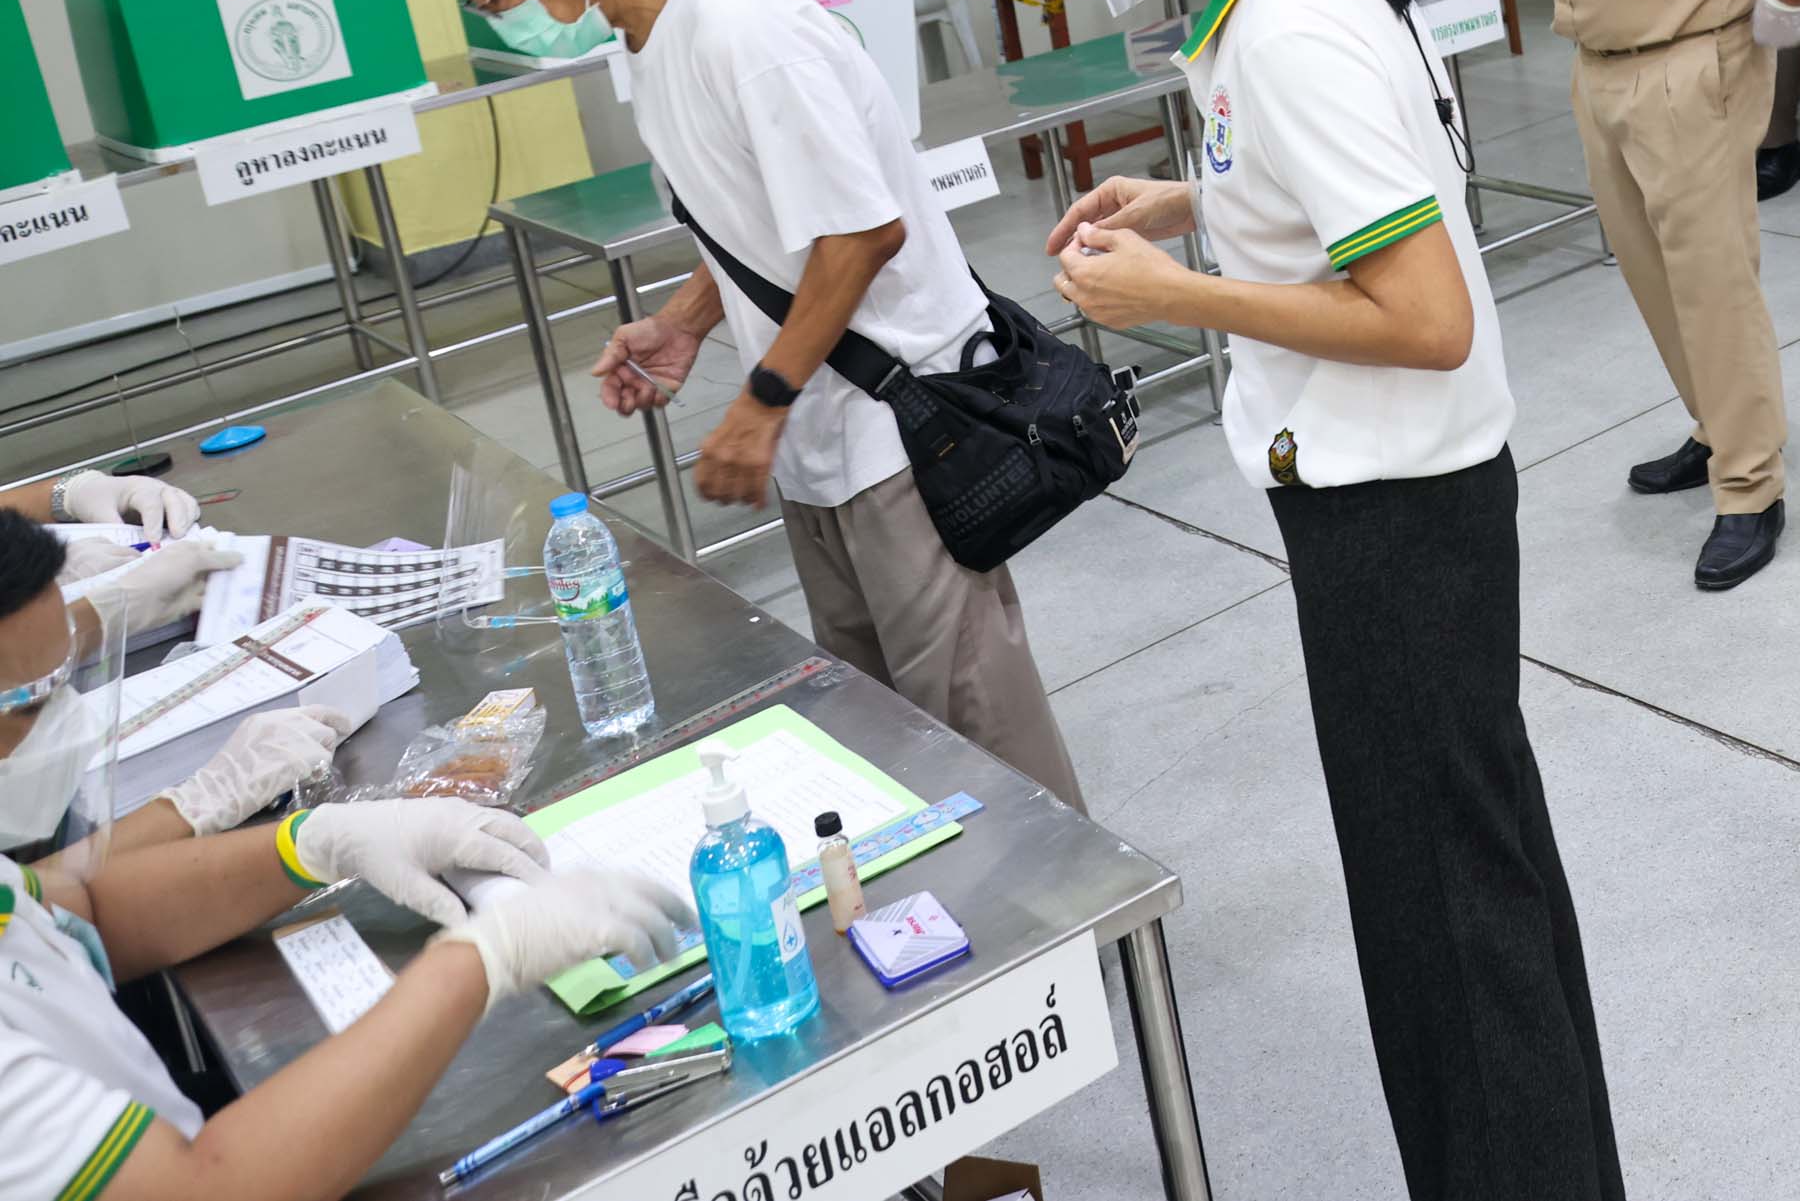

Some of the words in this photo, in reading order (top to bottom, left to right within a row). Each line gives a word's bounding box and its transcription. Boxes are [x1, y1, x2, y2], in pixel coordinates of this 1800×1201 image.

[235, 125, 388, 187] คูหาลงคะแนน
[672, 983, 1069, 1201] ืด้วยแอลกอฮอล์
